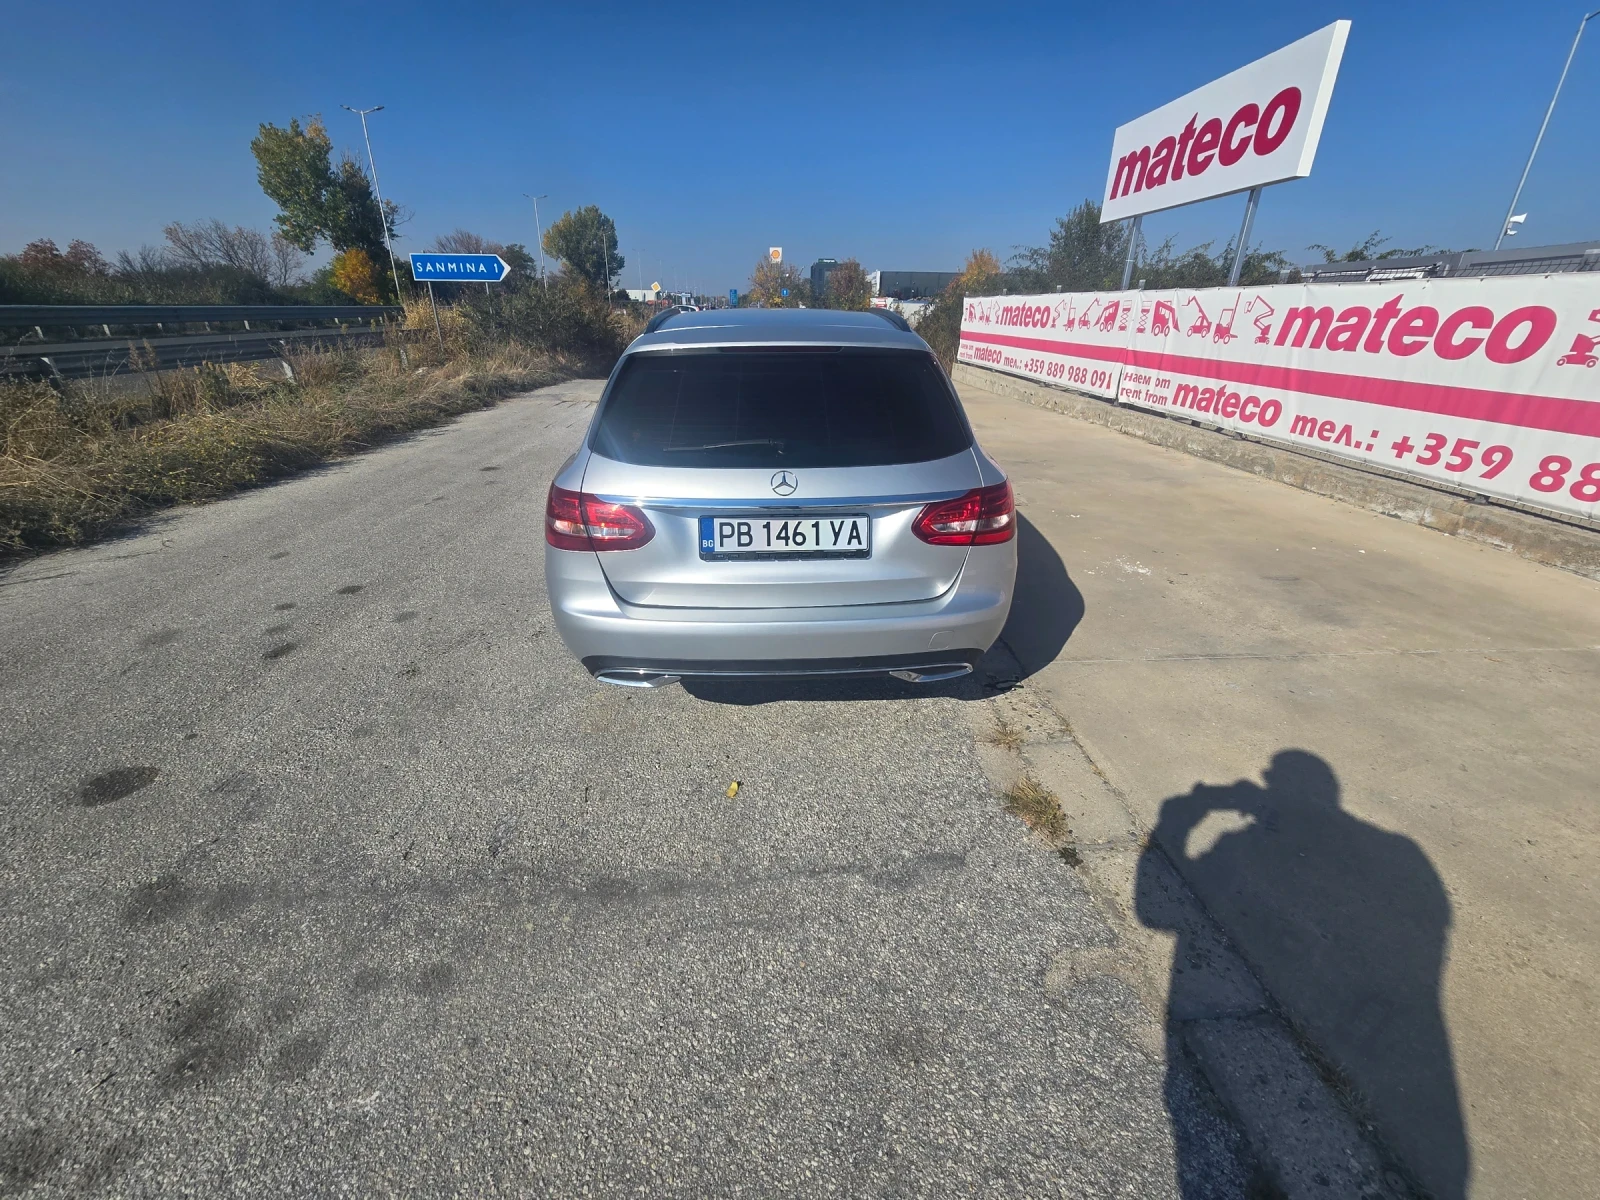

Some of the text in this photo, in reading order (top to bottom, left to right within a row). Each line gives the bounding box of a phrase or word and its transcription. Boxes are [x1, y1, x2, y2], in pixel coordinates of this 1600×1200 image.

[1109, 86, 1302, 201] mateco
[416, 262, 499, 273] SANMINA 1
[1000, 301, 1051, 328] mateco
[1274, 294, 1557, 364] mateco
[974, 346, 1003, 365] mateco
[1024, 358, 1045, 374] +359
[1046, 361, 1065, 379] 889
[1067, 365, 1088, 385] 988
[1120, 387, 1168, 407] rent from
[1171, 384, 1283, 428] mateco
[1390, 432, 1514, 480] +359
[702, 540, 714, 548] BG
[719, 522, 754, 548] PB
[762, 521, 820, 547] 1461
